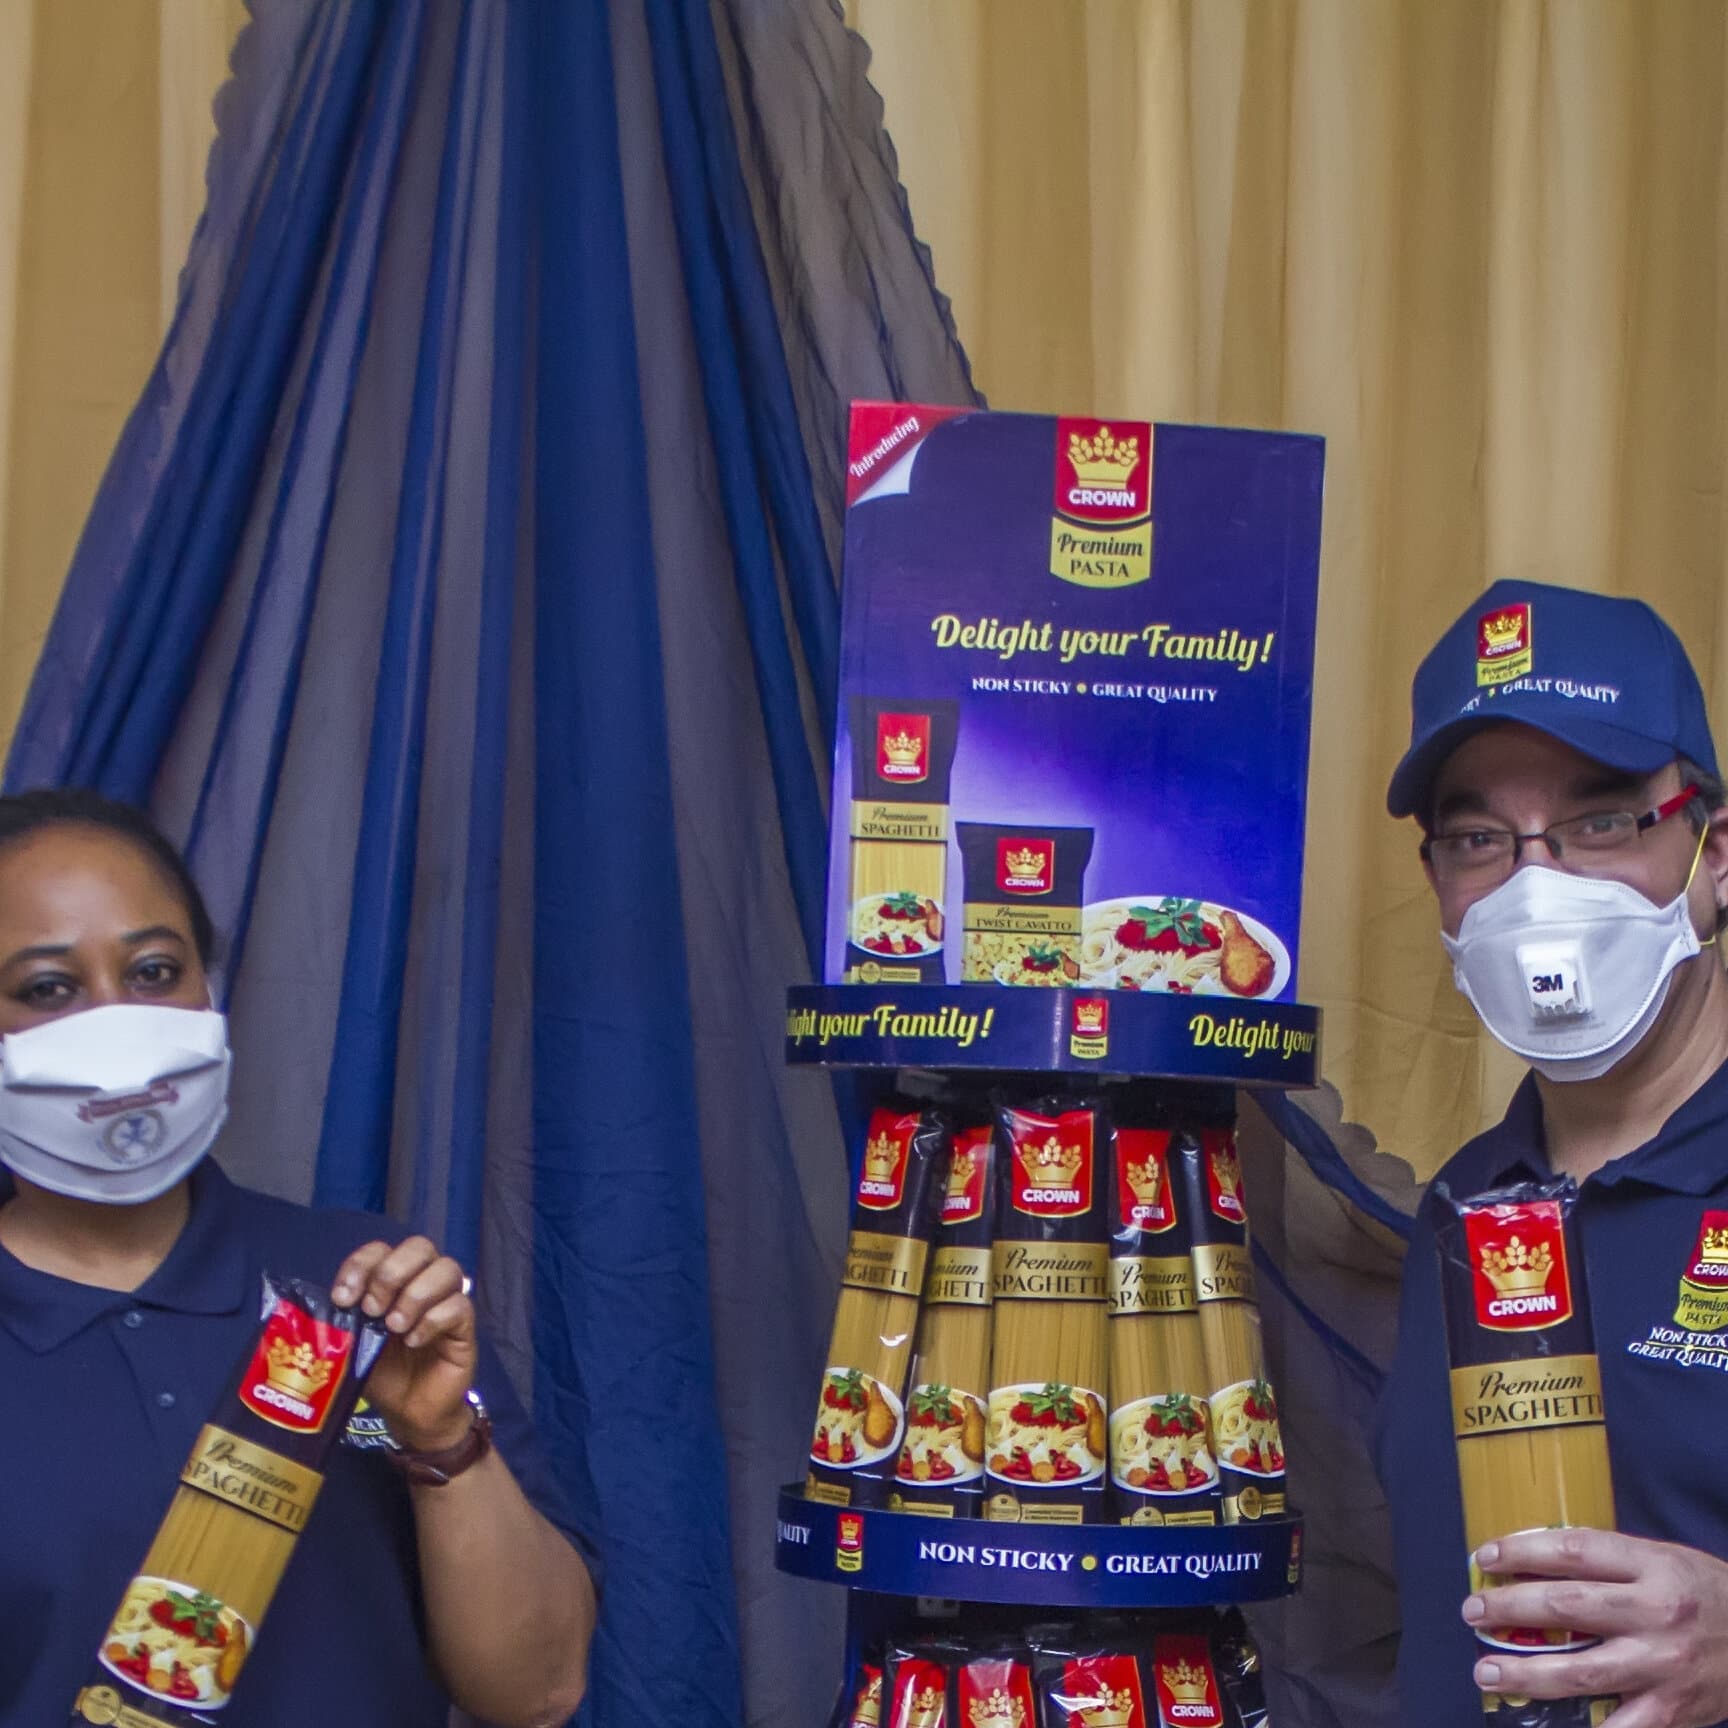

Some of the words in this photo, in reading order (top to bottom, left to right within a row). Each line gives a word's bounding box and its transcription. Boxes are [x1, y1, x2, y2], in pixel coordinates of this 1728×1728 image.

[850, 416, 920, 478] Introducing
[1069, 488, 1136, 509] CROWN
[1056, 532, 1145, 558] Premium
[1071, 559, 1130, 578] PASTA
[930, 614, 1053, 660] Delight
[1059, 629, 1140, 663] your
[1485, 640, 1522, 656] CROWN
[972, 677, 1010, 694] NON
[1013, 679, 1072, 695] STICKY
[1092, 682, 1147, 698] GREAT
[1148, 685, 1219, 704] QUALITY
[1502, 678, 1553, 695] GREAT
[1554, 680, 1620, 703] QUALITY
[860, 823, 940, 838] SPAGHETTI
[1005, 877, 1044, 888] CROWN
[1532, 973, 1564, 993] 3M
[819, 1012, 870, 1047] your
[1189, 1014, 1281, 1058] Delight
[859, 1181, 895, 1197] CROWN
[1022, 1188, 1080, 1204] CROWN
[1004, 1248, 1095, 1270] Premium
[1121, 1262, 1188, 1286] Premium
[1488, 1295, 1557, 1317] CROWN
[1649, 1326, 1685, 1343] NON
[1628, 1342, 1675, 1359] GREAT
[1479, 1370, 1584, 1399] Premium
[252, 1383, 315, 1421] CROWN
[1464, 1394, 1602, 1428] SPAGHETTI
[203, 1438, 298, 1493] Premium
[919, 1541, 975, 1564] NON
[979, 1547, 1075, 1572] STICKY
[1106, 1554, 1182, 1574] GREAT
[1184, 1552, 1263, 1579] QUALITY
[1171, 1705, 1215, 1718] CROWN
